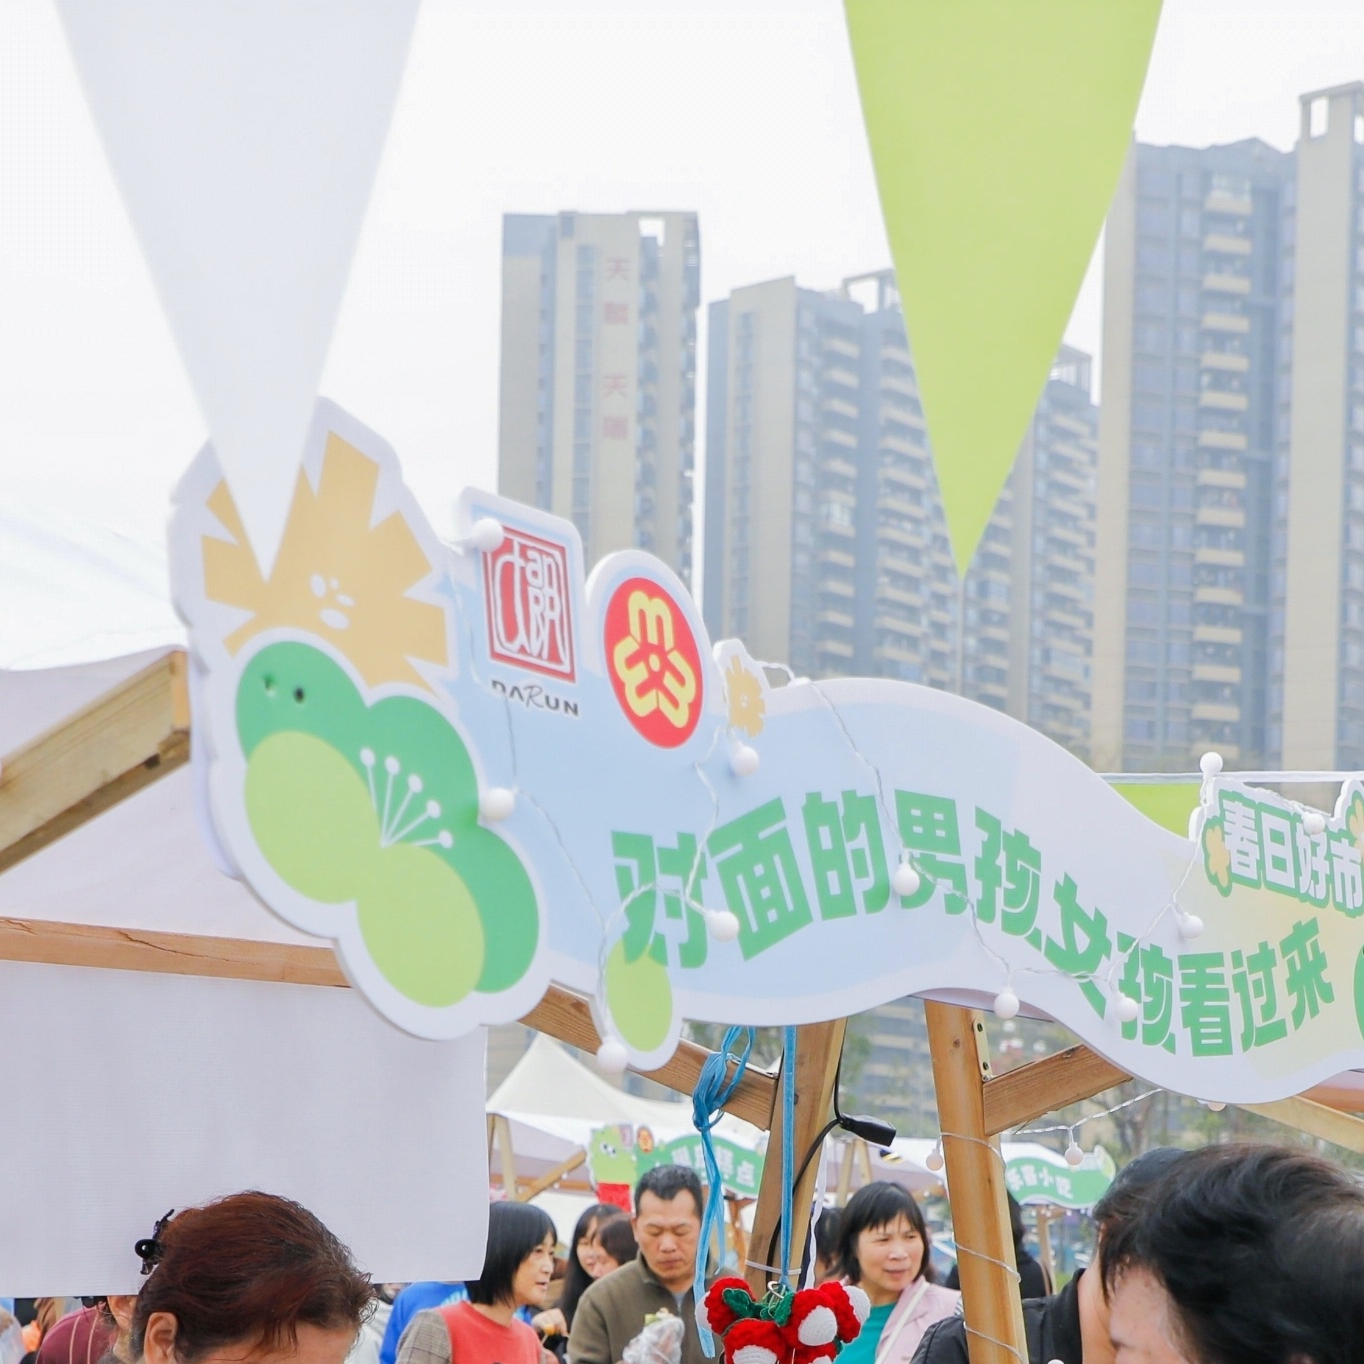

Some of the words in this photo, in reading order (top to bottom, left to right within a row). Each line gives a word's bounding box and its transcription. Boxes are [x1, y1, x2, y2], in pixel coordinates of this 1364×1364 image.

[610, 789, 1335, 1057] 对面的男孩女孩看过来
[1222, 799, 1363, 910] 春日好市
